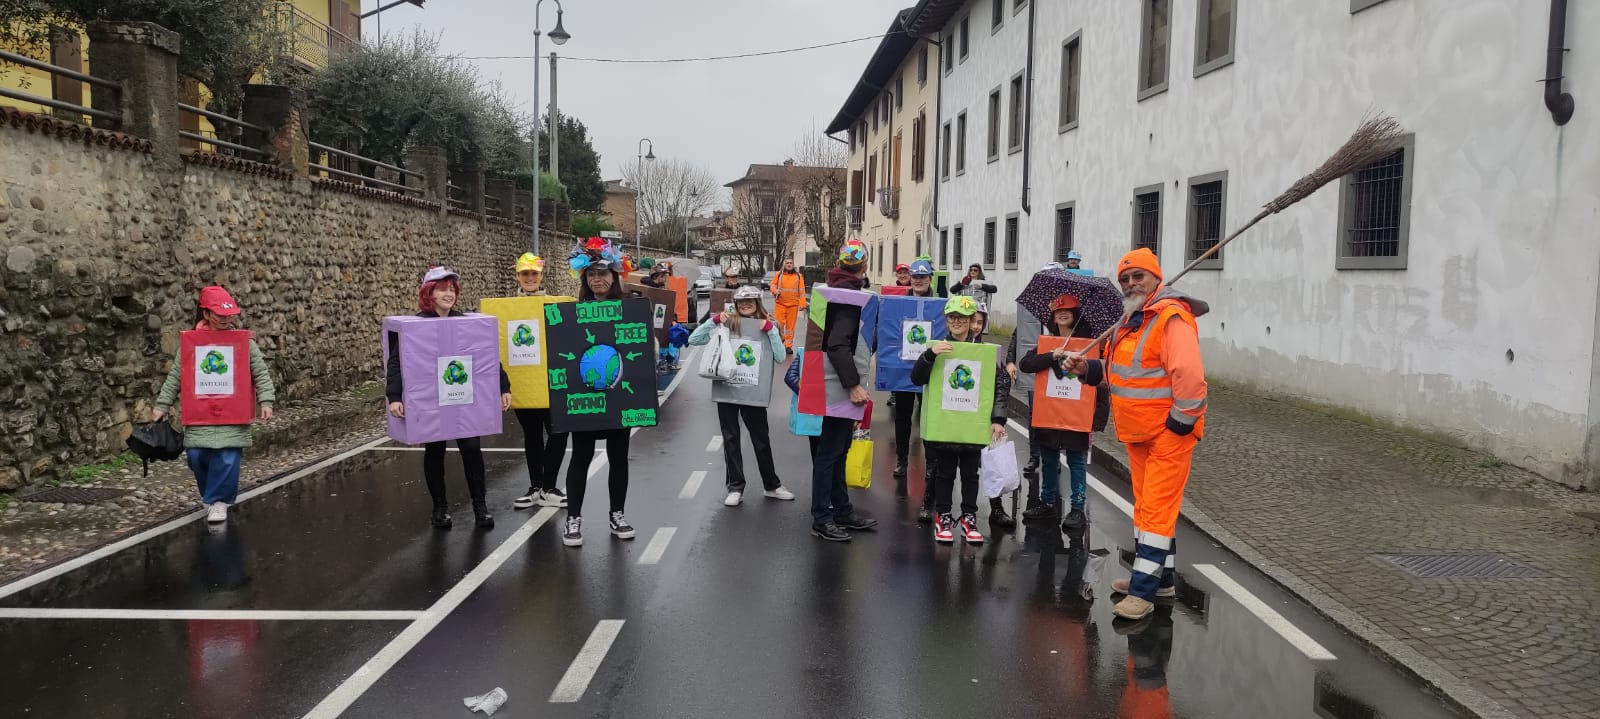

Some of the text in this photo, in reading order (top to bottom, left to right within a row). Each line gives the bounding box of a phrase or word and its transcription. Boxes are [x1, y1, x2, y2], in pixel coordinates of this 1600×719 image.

[577, 303, 622, 319] GLUTEN
[616, 326, 647, 340] FREE
[550, 372, 567, 387] LO
[567, 396, 605, 410] AMANO
